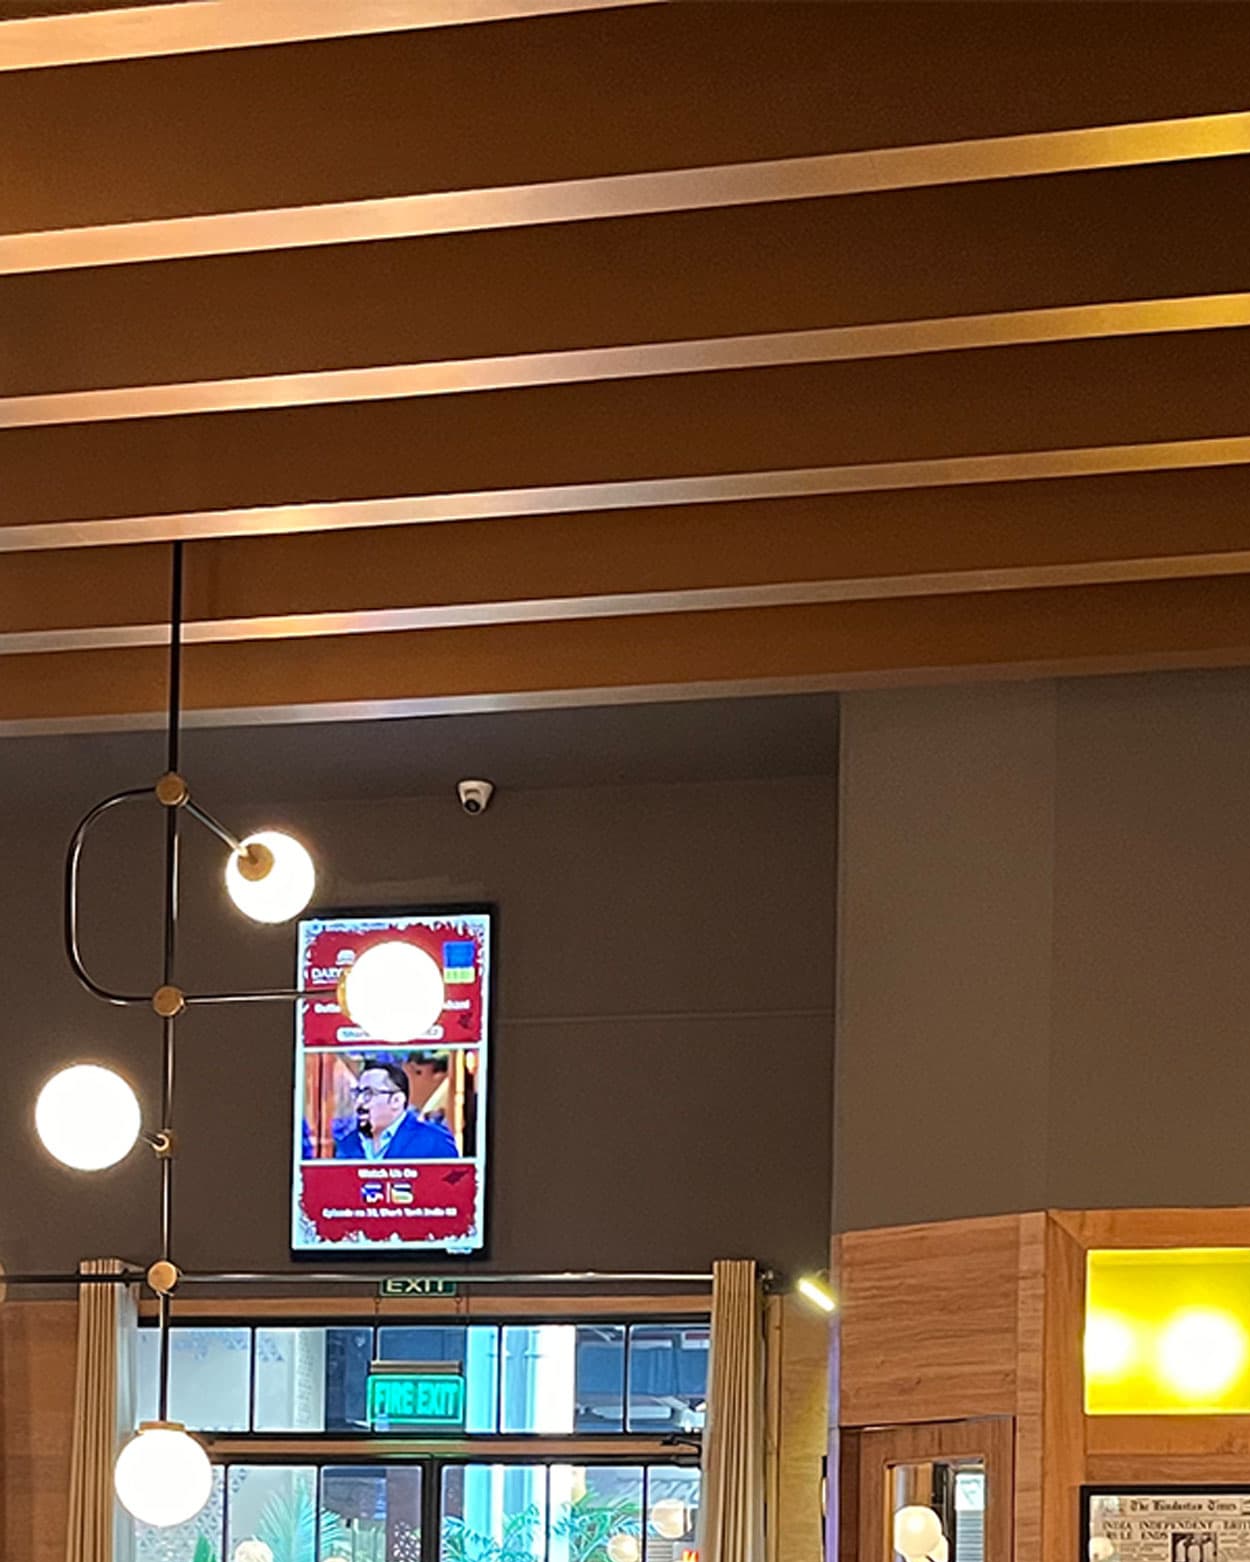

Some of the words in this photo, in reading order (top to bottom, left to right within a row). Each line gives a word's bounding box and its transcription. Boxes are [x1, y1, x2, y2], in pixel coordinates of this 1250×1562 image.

[386, 1279, 445, 1293] EXIT
[374, 1381, 414, 1416] FIRE
[417, 1381, 459, 1416] EXIT
[1130, 1499, 1149, 1511] The
[1153, 1499, 1203, 1511] Hindustan
[1207, 1499, 1238, 1511] Times
